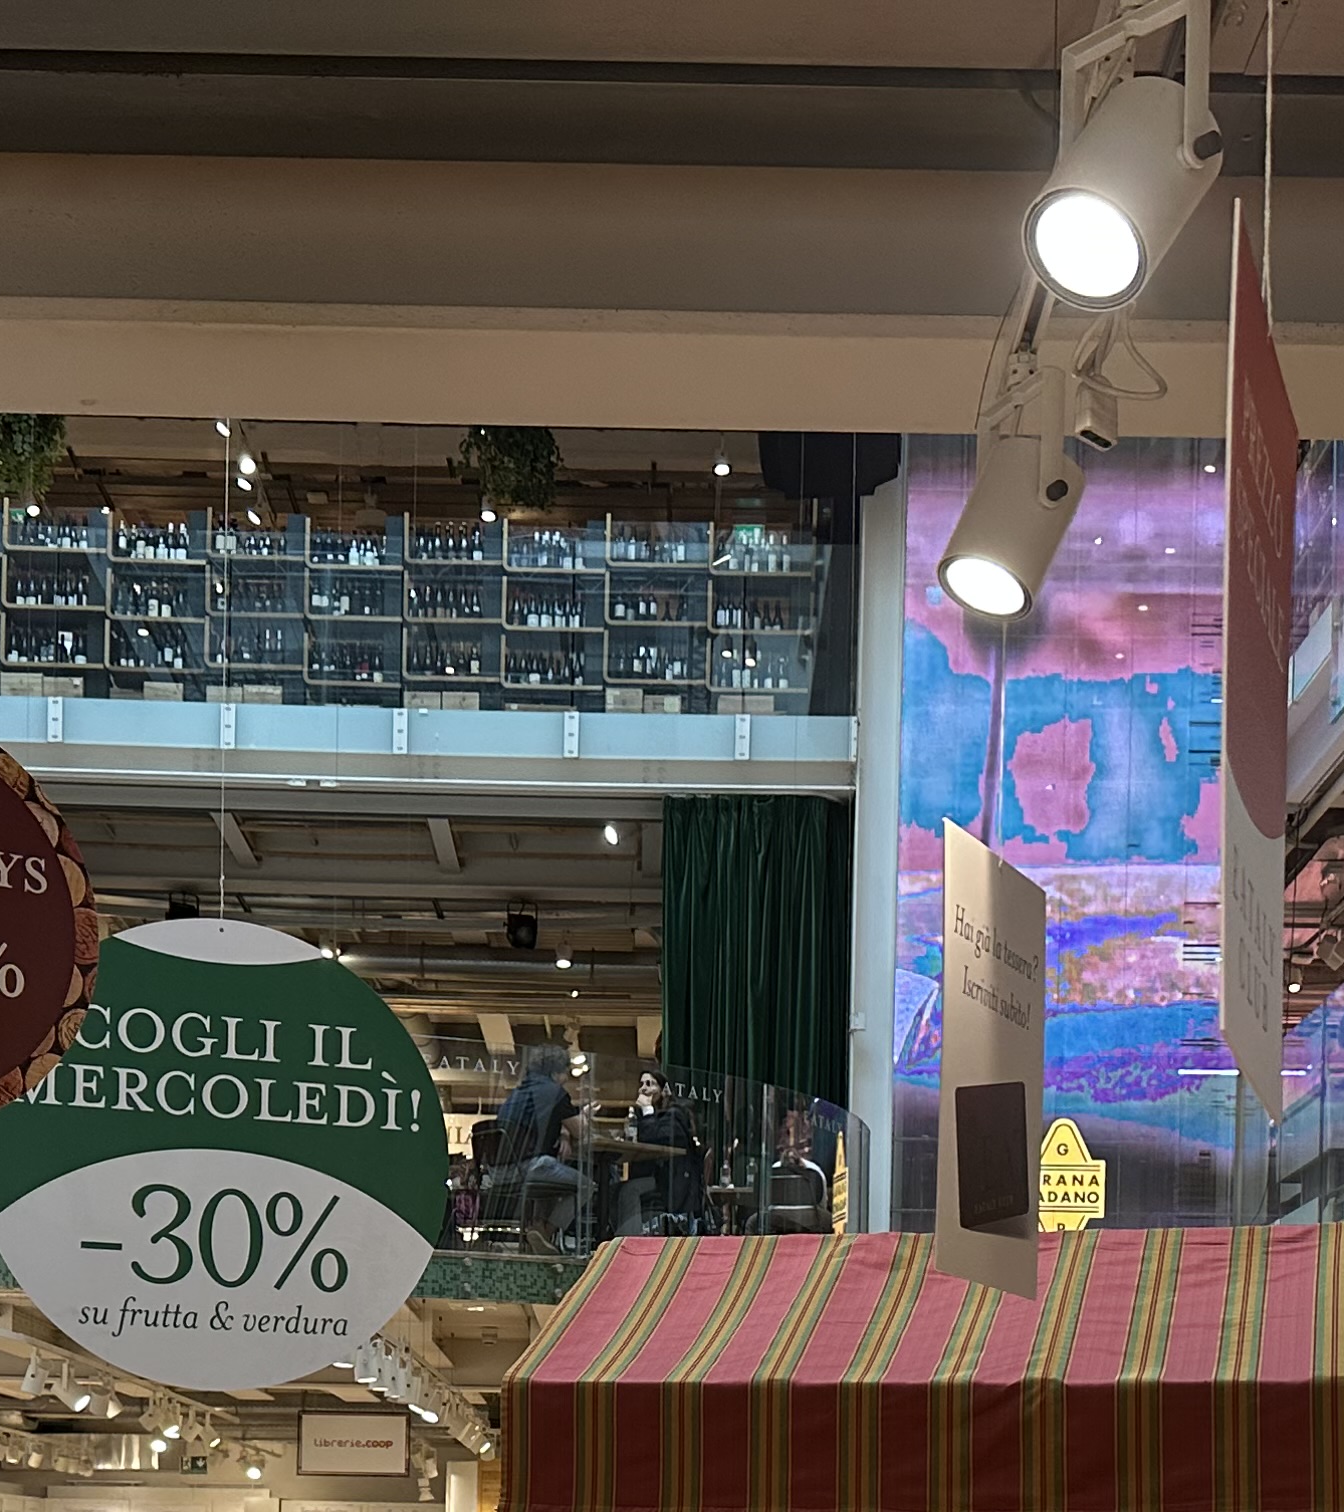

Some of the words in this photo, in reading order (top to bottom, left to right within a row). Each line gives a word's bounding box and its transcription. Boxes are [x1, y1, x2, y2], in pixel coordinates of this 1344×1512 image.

[953, 903, 974, 941] Hai
[975, 923, 990, 958] già
[992, 927, 1002, 955] la
[1004, 945, 1039, 983] tessera?
[961, 964, 999, 1018] Iscriviti
[999, 993, 1031, 1030] subito!
[75, 1001, 280, 1064] COGLI
[308, 1022, 373, 1070] IL
[18, 1062, 424, 1135] MERCOLEDÌ!
[662, 1081, 724, 1104] ATALY
[1039, 1191, 1100, 1203] ADANO
[1043, 1174, 1100, 1187] RANA
[80, 1182, 350, 1294] -30%
[78, 1304, 111, 1329] su
[110, 1295, 200, 1339] frutta
[208, 1300, 236, 1333] &
[241, 1296, 349, 1338] verdura
